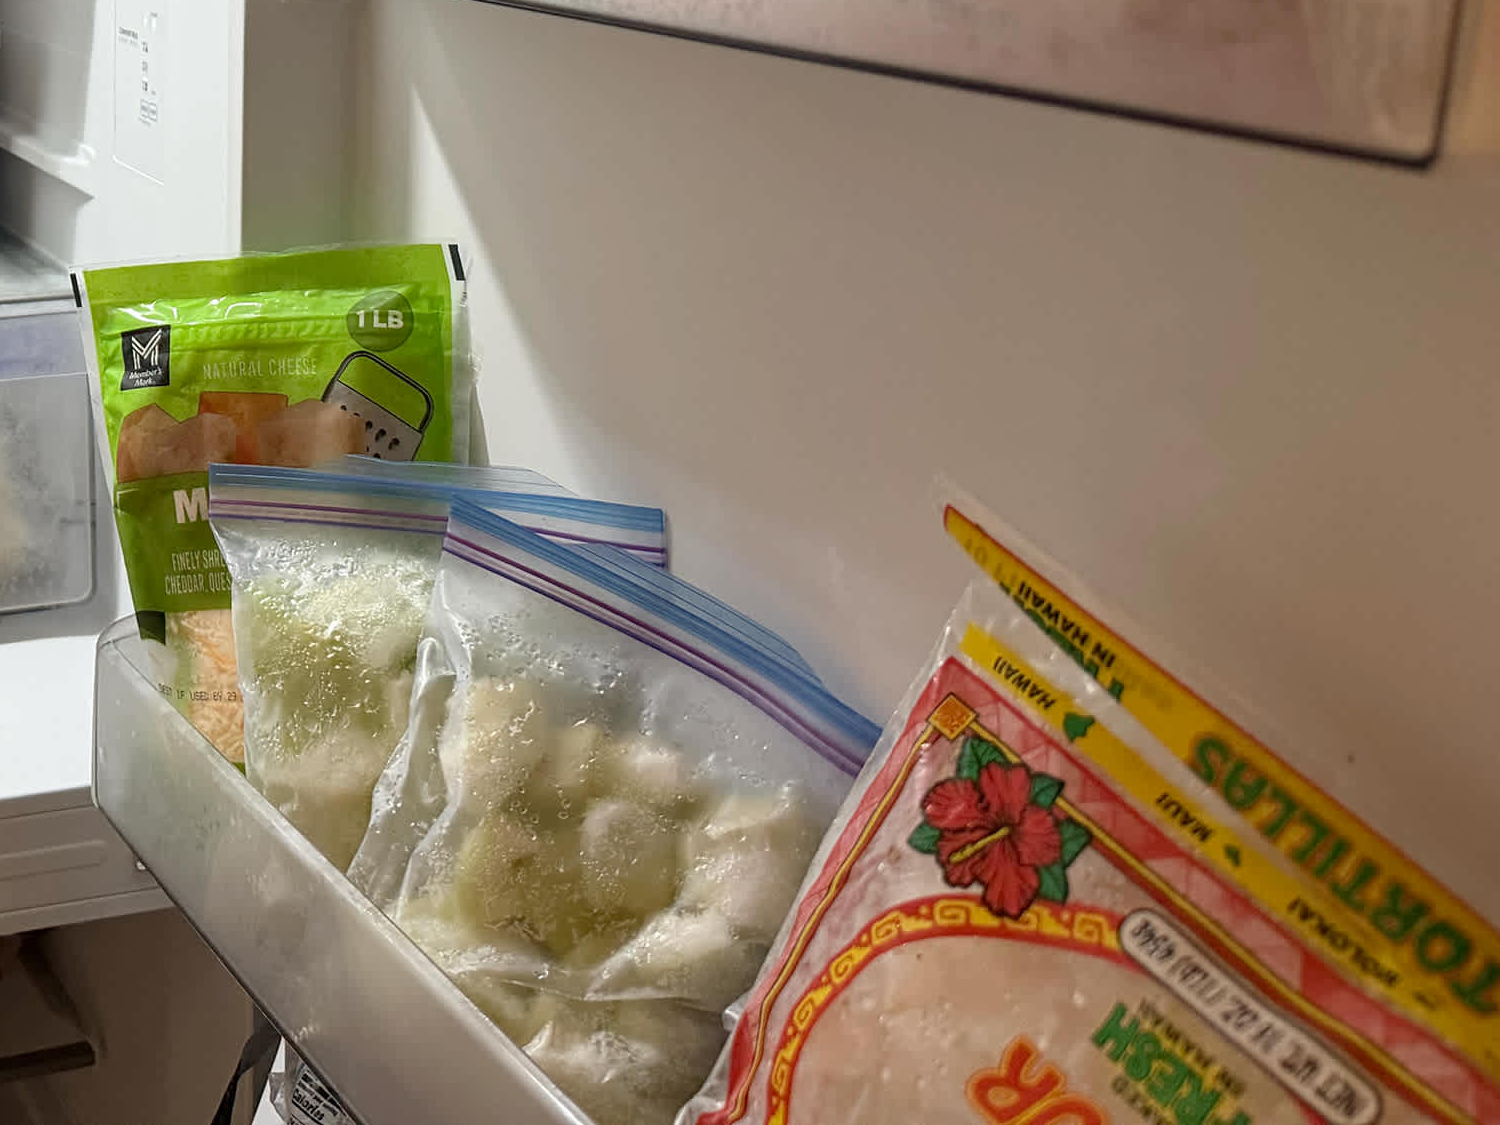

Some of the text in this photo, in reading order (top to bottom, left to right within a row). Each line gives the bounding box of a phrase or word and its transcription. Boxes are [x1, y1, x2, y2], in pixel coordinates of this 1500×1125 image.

[355, 310, 404, 329] 1 LB
[129, 367, 163, 380] Member's
[203, 357, 318, 380] NATURAL CHEESE
[171, 550, 200, 572] FINELY
[1018, 581, 1117, 669] IN HAWAII
[189, 690, 209, 701] USED
[993, 656, 1057, 710] HAWAII
[1156, 792, 1214, 842] MAUI
[1196, 736, 1500, 1015] TORTILLAS
[1090, 1002, 1251, 1125] RESH
[293, 1088, 324, 1121] Calories
